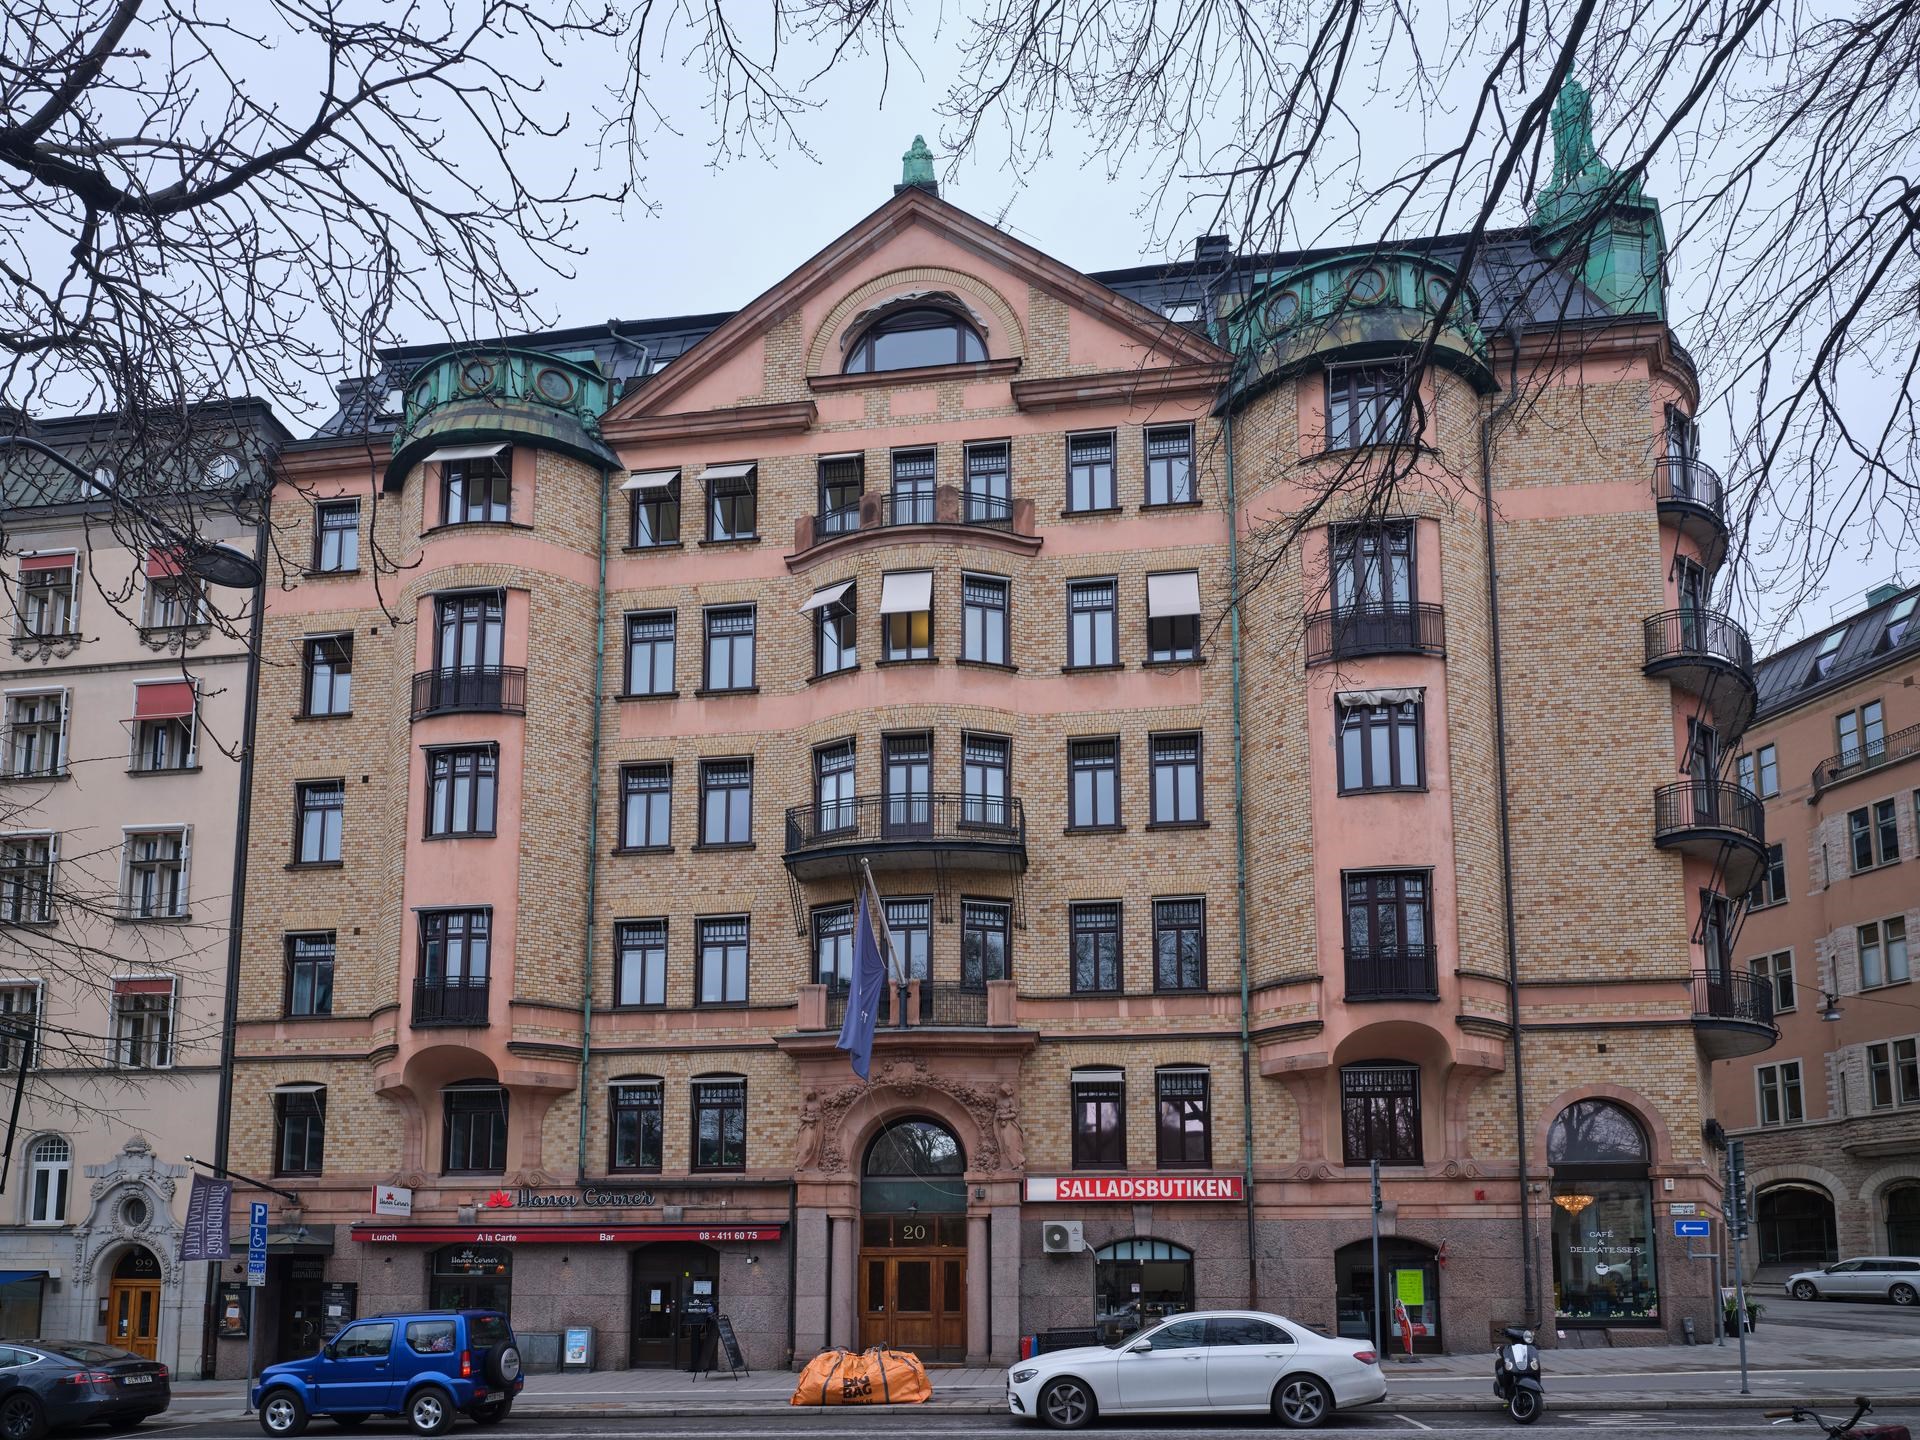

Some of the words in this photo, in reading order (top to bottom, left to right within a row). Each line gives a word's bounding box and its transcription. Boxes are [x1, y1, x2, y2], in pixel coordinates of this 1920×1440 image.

[582, 1187, 656, 1208] Corner
[254, 1204, 265, 1224] P
[371, 1233, 397, 1241] Lunch
[476, 1233, 485, 1241] A
[485, 1233, 493, 1241] la
[494, 1233, 517, 1241] Carte
[600, 1233, 615, 1241] Bar
[699, 1231, 710, 1240] 08
[717, 1231, 732, 1240] 411
[734, 1231, 745, 1240] 60
[747, 1231, 758, 1240] 75
[903, 1225, 926, 1240] 20
[1589, 1229, 1614, 1238] CAFÉ
[1569, 1246, 1641, 1254] DELIKATESSER
[843, 1383, 873, 1398] BAG
